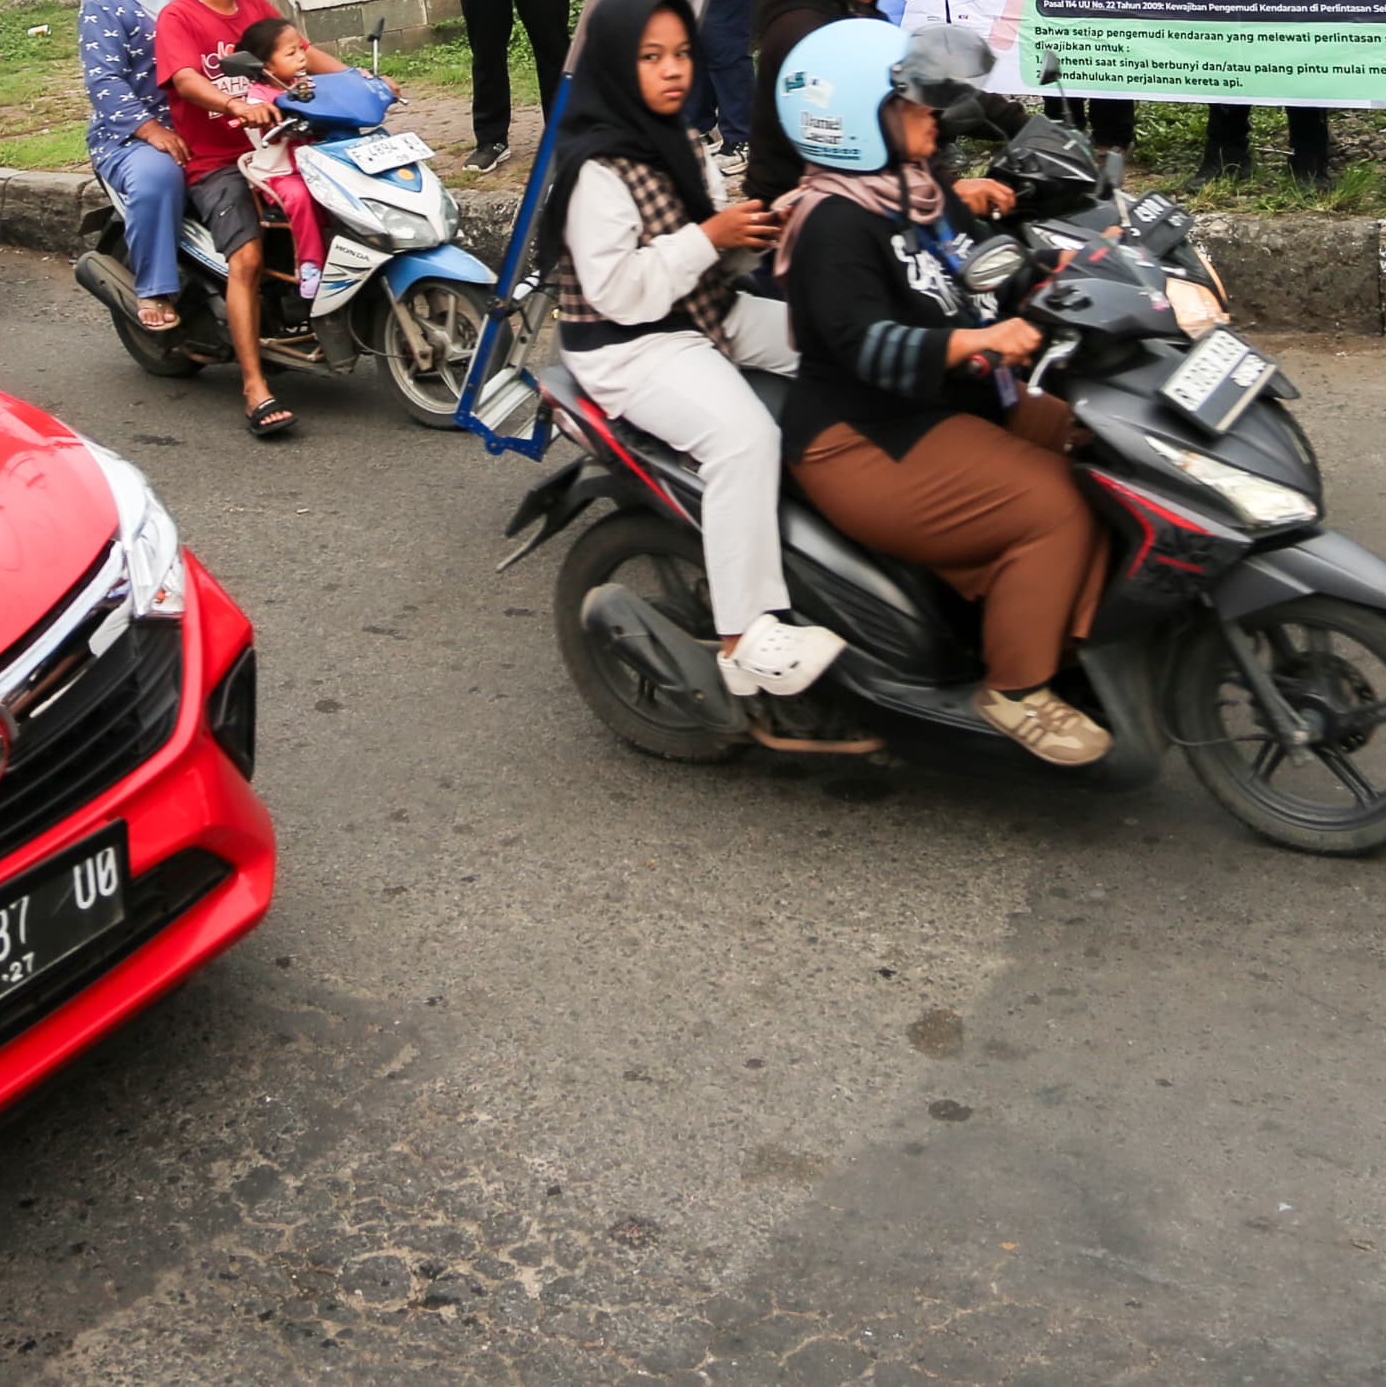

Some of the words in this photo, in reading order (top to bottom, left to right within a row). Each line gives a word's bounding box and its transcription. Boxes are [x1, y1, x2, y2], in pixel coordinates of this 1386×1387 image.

[1043, 0, 1064, 9] Pasal
[1064, 0, 1077, 9] 114
[1078, 0, 1091, 9] UU
[1091, 0, 1105, 9] No.
[1105, 0, 1116, 10] 22
[1116, 1, 1141, 10] Tahun
[1142, 2, 1164, 11] 2009:
[1165, 2, 1207, 12] Kewajiban
[1208, 3, 1258, 14] Pengemudi
[1259, 3, 1308, 13] Kendaraan
[1309, 3, 1319, 13] di
[1320, 4, 1372, 14] Perlintasan
[1035, 26, 1070, 37] Bahwa
[1072, 27, 1104, 39] setiap
[1106, 29, 1165, 41] pengemudi
[1167, 30, 1224, 41] kendaraan
[1226, 32, 1254, 43] yang
[1257, 32, 1311, 43] melewati
[1314, 33, 1382, 44] perlintasan
[1035, 41, 1092, 53] diwajibkan
[1094, 43, 1125, 53] untuk
[1051, 55, 1093, 67] erhenti
[1095, 57, 1117, 67] saat
[1119, 57, 1149, 70] sinyal
[1151, 59, 1199, 71] berbunyi
[1201, 61, 1251, 73] dan/atau
[1254, 62, 1294, 75] palang
[1297, 63, 1329, 74] pintu
[1332, 64, 1365, 75] mulai
[1126, 73, 1182, 85] perjalanan
[1184, 76, 1220, 87] kereta
[1222, 77, 1243, 88] api.
[335, 244, 370, 262] HONDA
